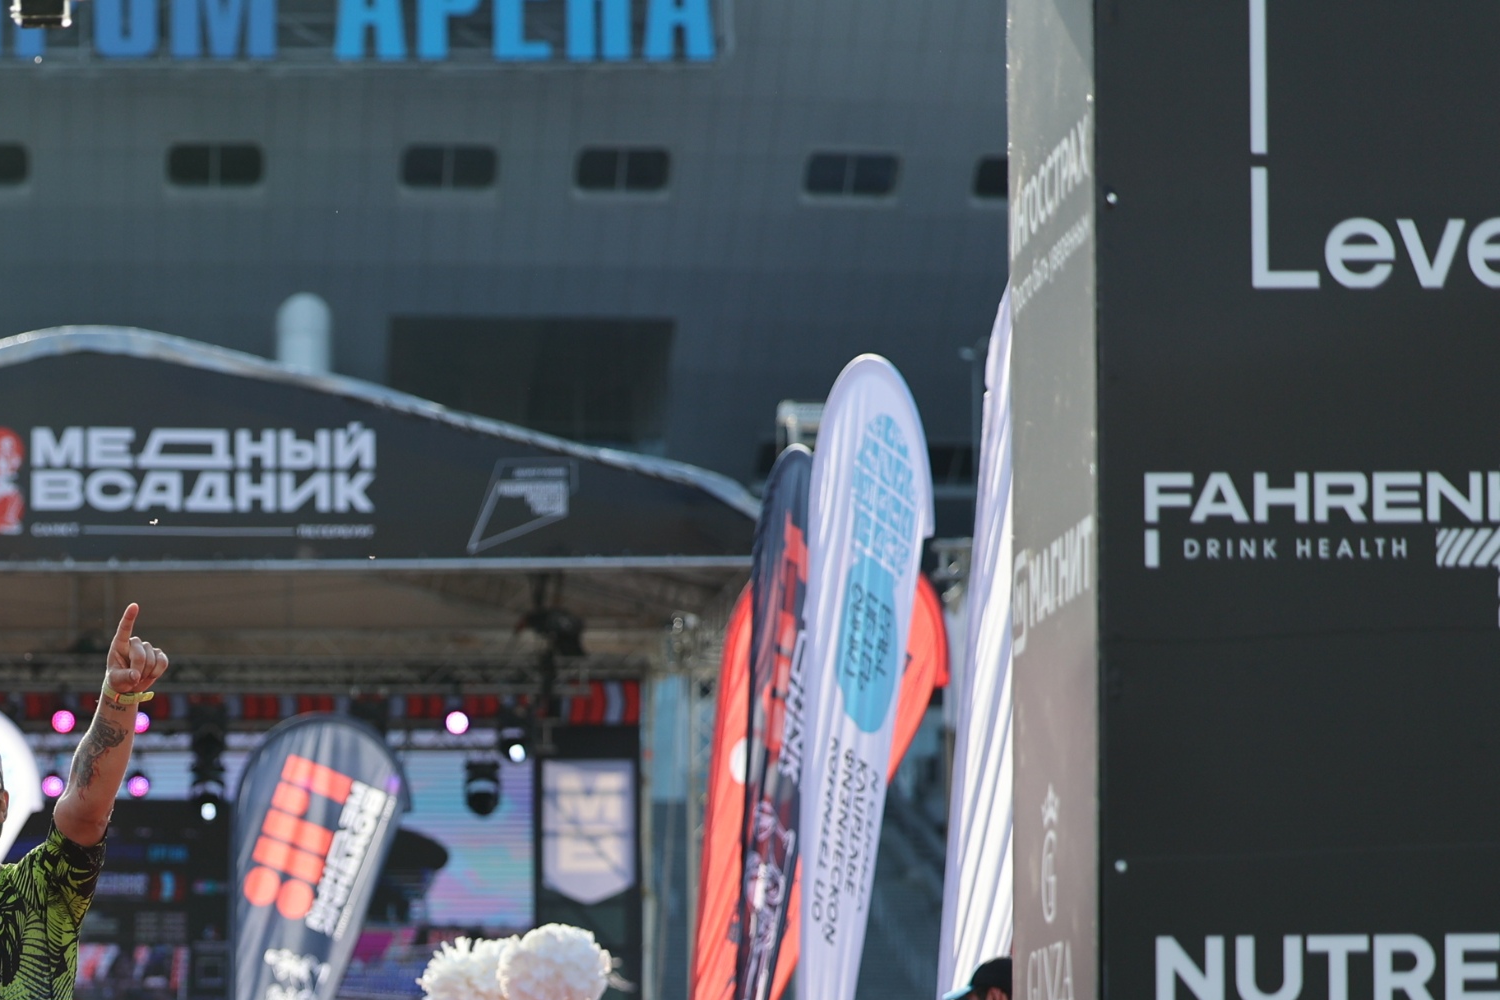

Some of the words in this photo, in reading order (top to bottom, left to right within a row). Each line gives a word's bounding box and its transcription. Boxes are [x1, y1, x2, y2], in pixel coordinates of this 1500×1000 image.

[30, 421, 376, 469] МЕДНЫЙ
[30, 469, 375, 512] ВСАДНИК
[1144, 472, 1500, 522] FAHREN
[1184, 537, 1278, 560] DRINK
[1297, 536, 1408, 560] HEALTH
